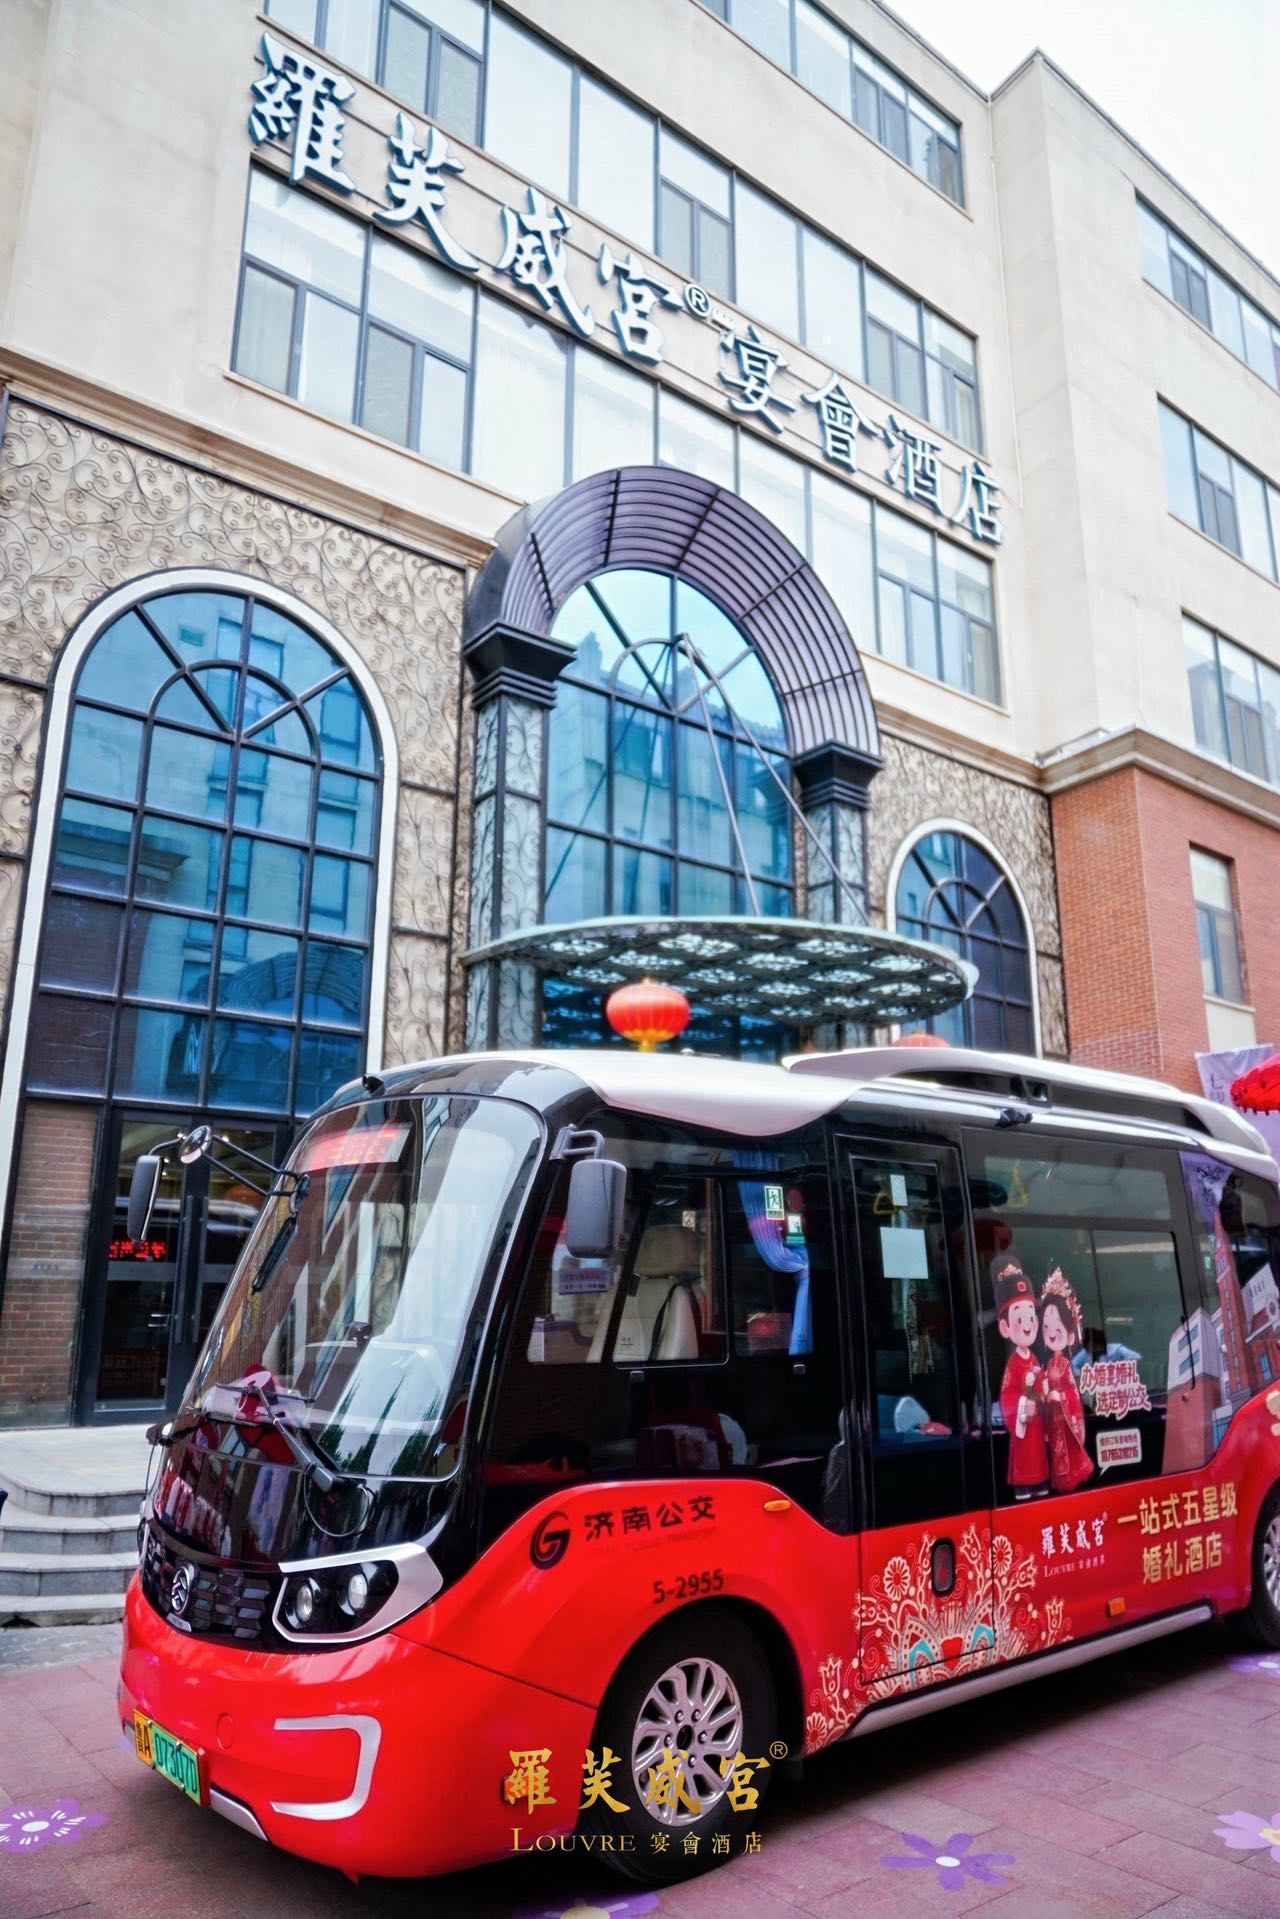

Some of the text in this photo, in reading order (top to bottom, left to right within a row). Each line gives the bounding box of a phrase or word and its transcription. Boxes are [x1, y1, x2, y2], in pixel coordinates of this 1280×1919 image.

[717, 326, 1002, 545] 宴會酒店
[584, 1496, 718, 1541] 济南公交
[1117, 1482, 1238, 1535] 一站式五星级
[1142, 1531, 1222, 1584] 婚礼酒店
[653, 1569, 724, 1604] 5-2955
